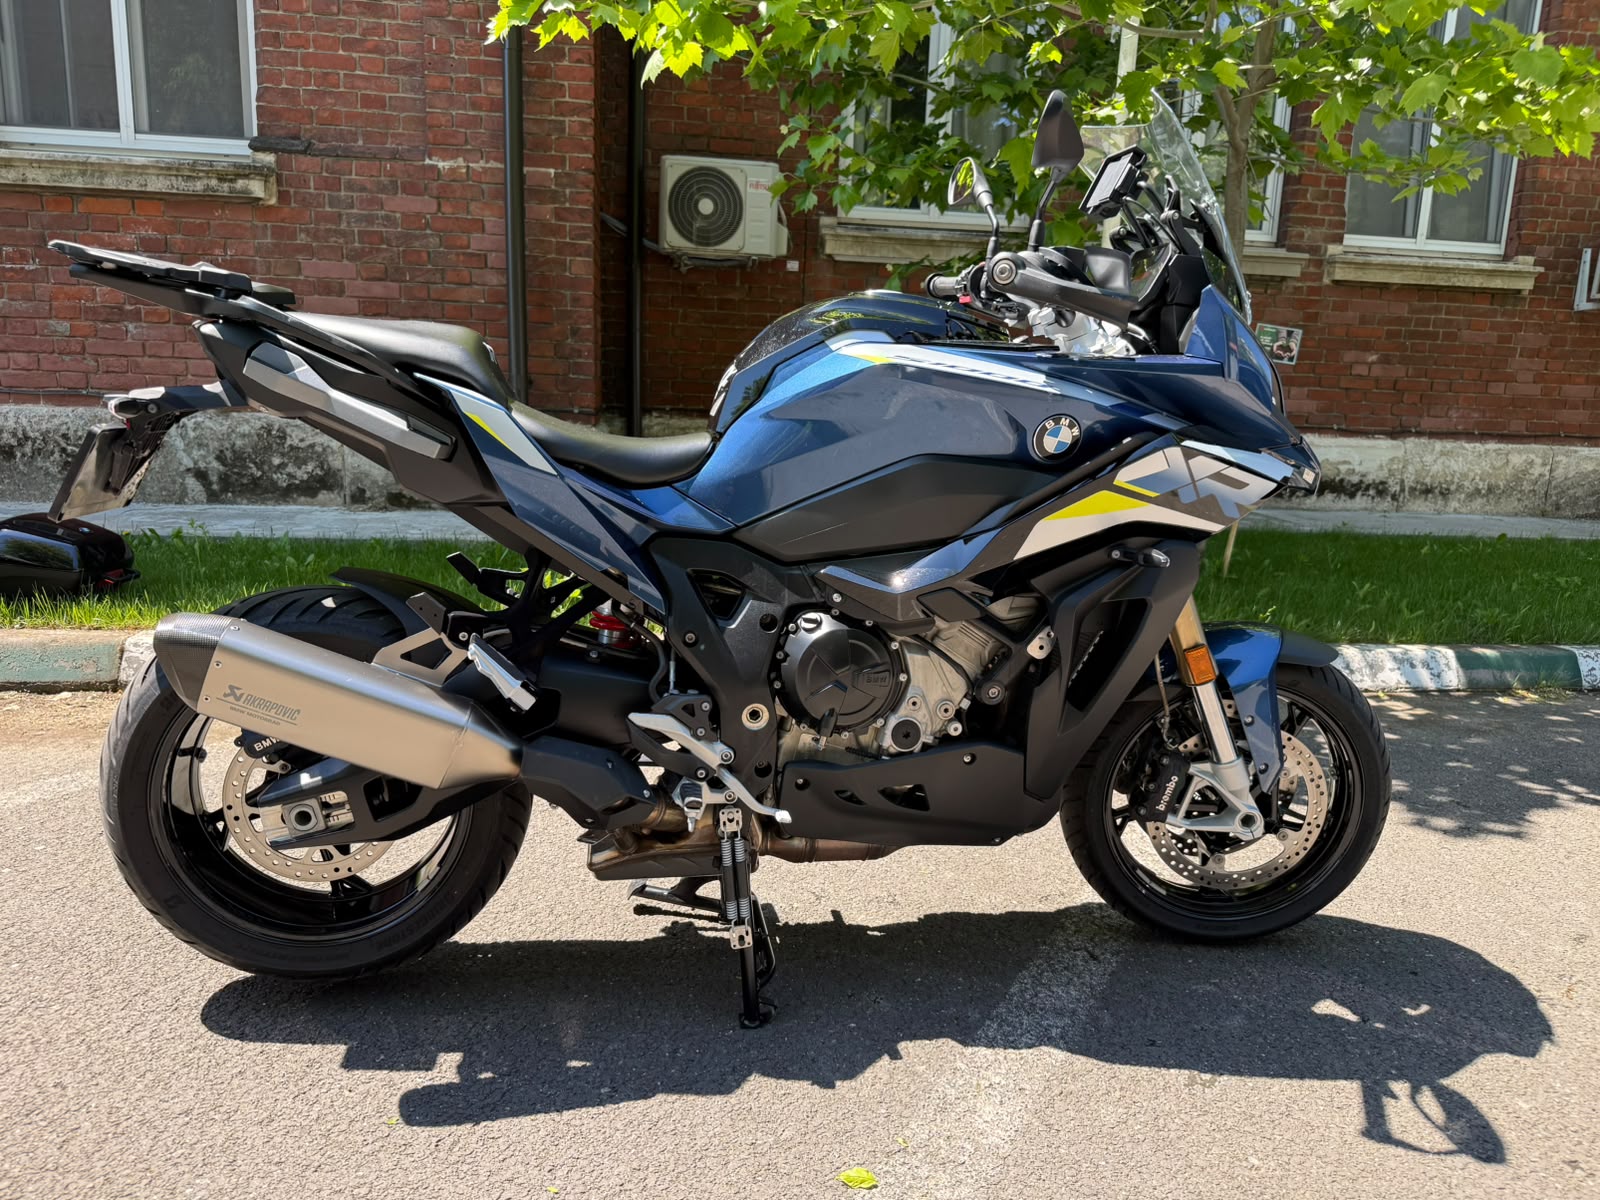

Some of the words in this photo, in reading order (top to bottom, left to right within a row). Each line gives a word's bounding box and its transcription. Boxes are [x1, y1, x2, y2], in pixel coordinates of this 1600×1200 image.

[1045, 418, 1080, 436] BMW
[866, 675, 888, 684] BMW
[246, 711, 281, 726] MOTORRAD
[254, 736, 280, 751] BMW
[1156, 775, 1178, 811] brembo
